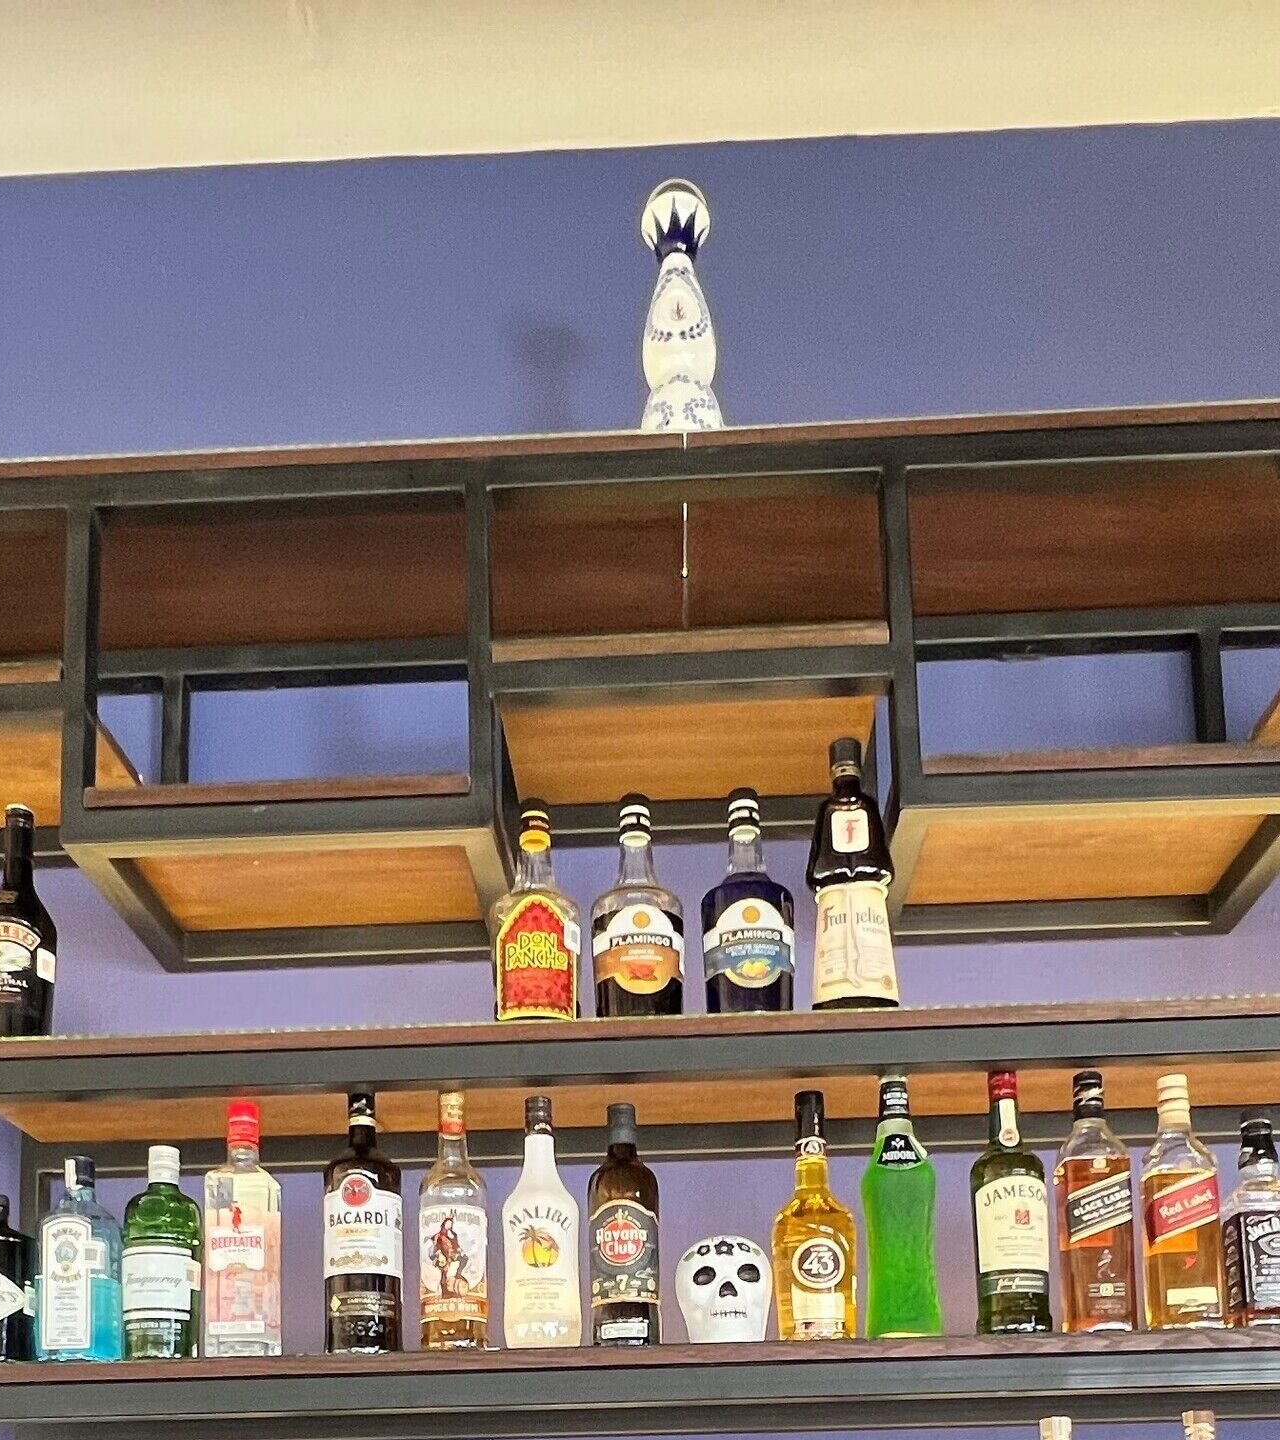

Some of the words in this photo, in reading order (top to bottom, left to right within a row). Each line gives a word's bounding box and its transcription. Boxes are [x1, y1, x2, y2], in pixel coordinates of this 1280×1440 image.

[518, 932, 556, 950] DON
[611, 934, 670, 947] FLAMINGO
[721, 930, 780, 943] FLAMINGO
[505, 943, 569, 971] PANCHO
[882, 1148, 917, 1162] MIDORI
[983, 1184, 1048, 1207] JAMESO
[1159, 1200, 1184, 1219] Red
[1184, 1189, 1215, 1210] Label
[508, 1205, 571, 1233] MALIBU
[211, 1236, 262, 1250] BEEFEATER
[596, 1227, 647, 1244] Havana
[605, 1239, 637, 1256] Club
[801, 1250, 835, 1275] 43
[616, 1275, 628, 1290] 7
